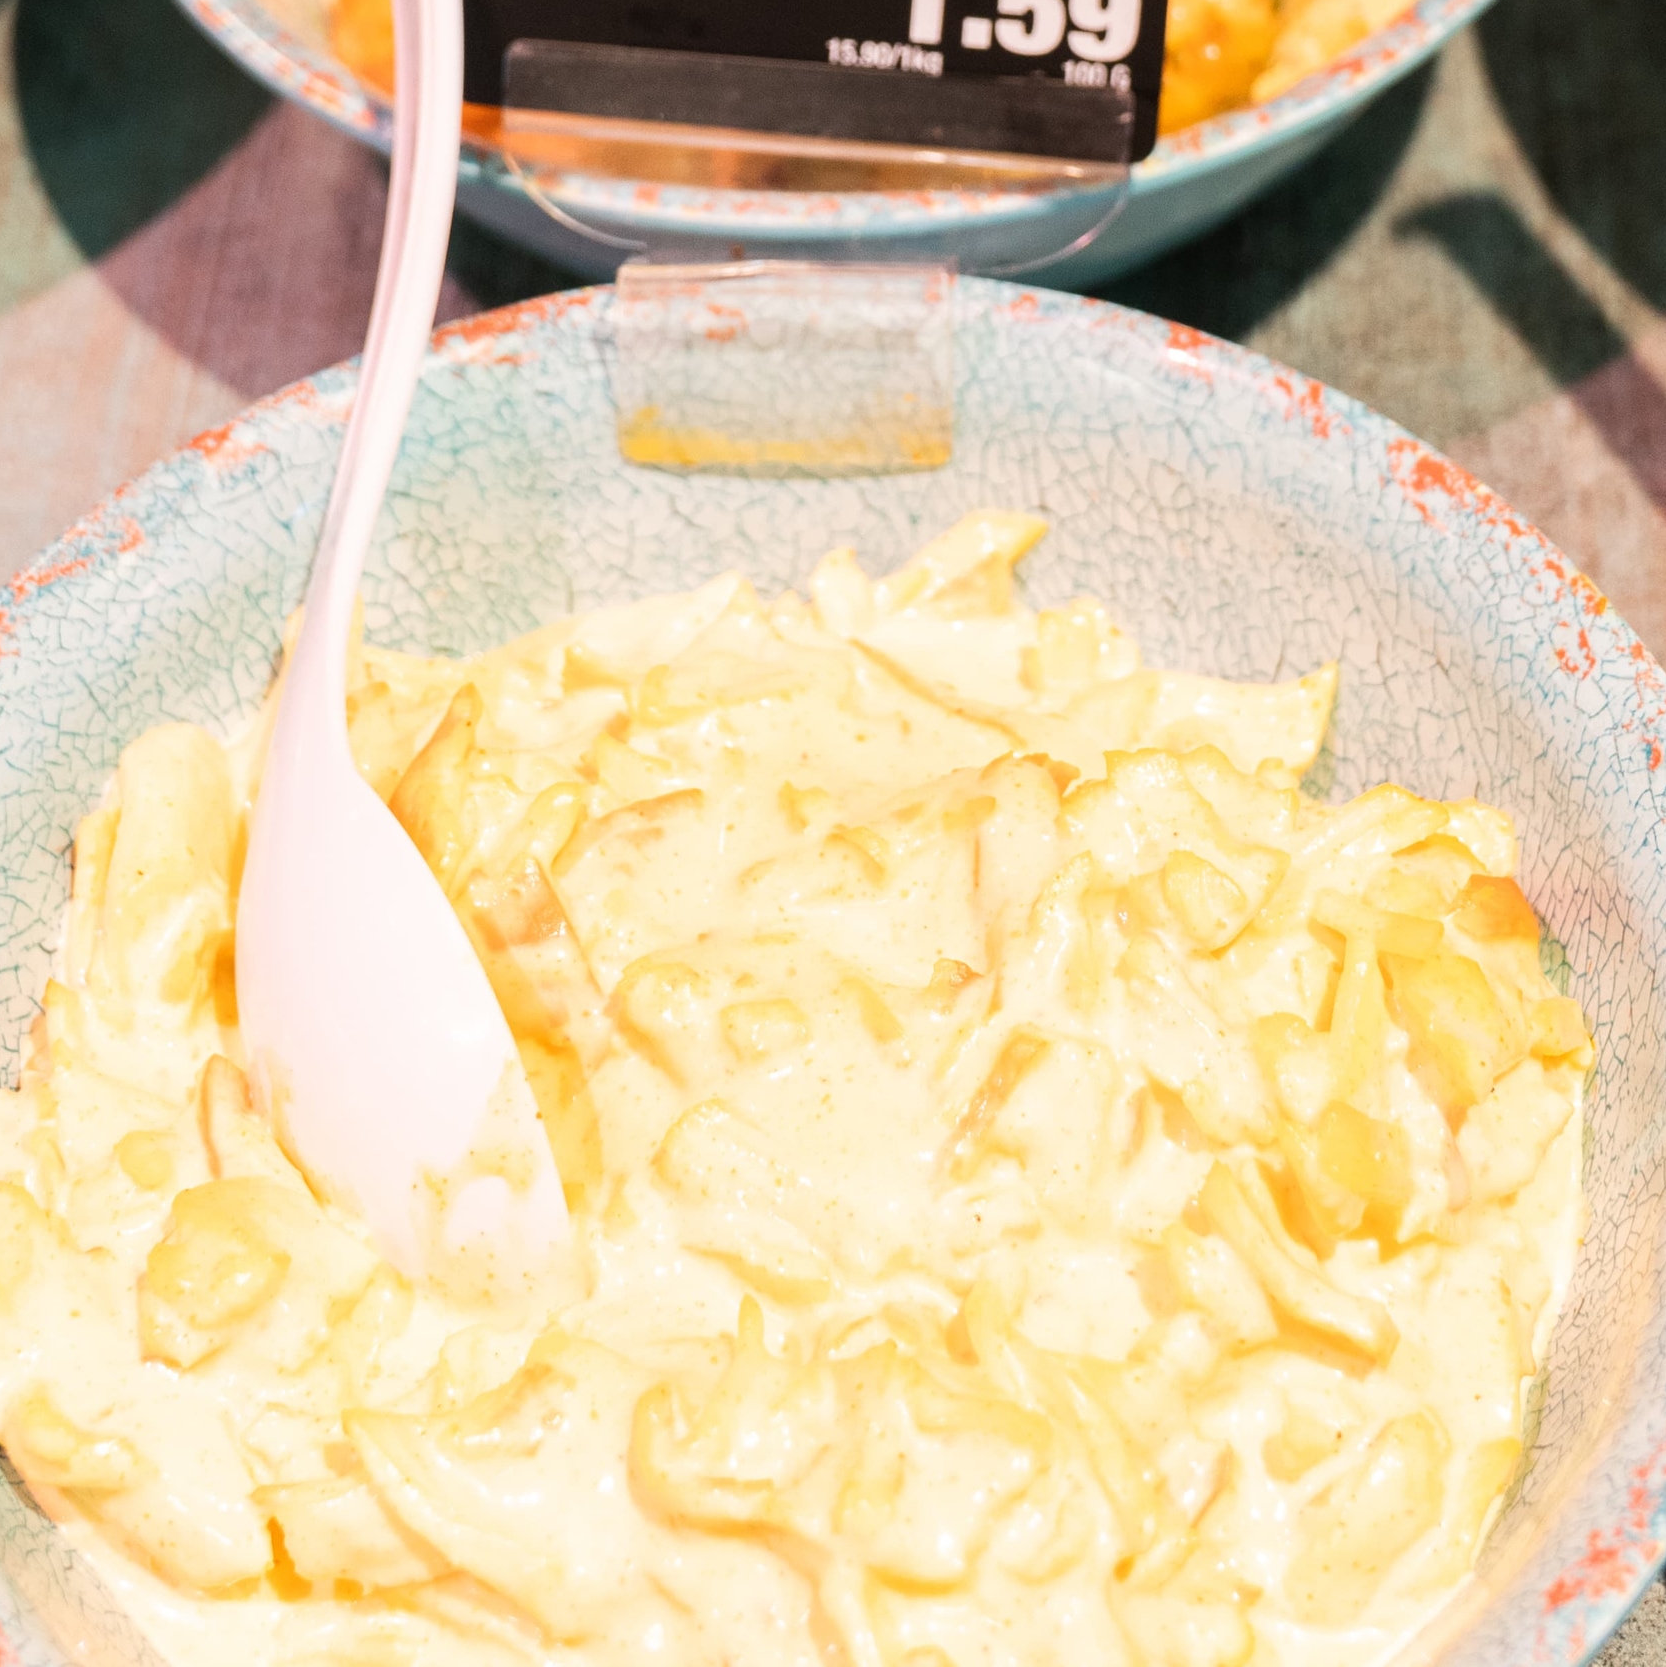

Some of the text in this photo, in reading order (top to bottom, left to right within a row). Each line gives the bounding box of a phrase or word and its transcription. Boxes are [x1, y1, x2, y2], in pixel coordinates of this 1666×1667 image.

[826, 36, 944, 77] 15.90/1kg
[1062, 59, 1132, 95] 100 G
